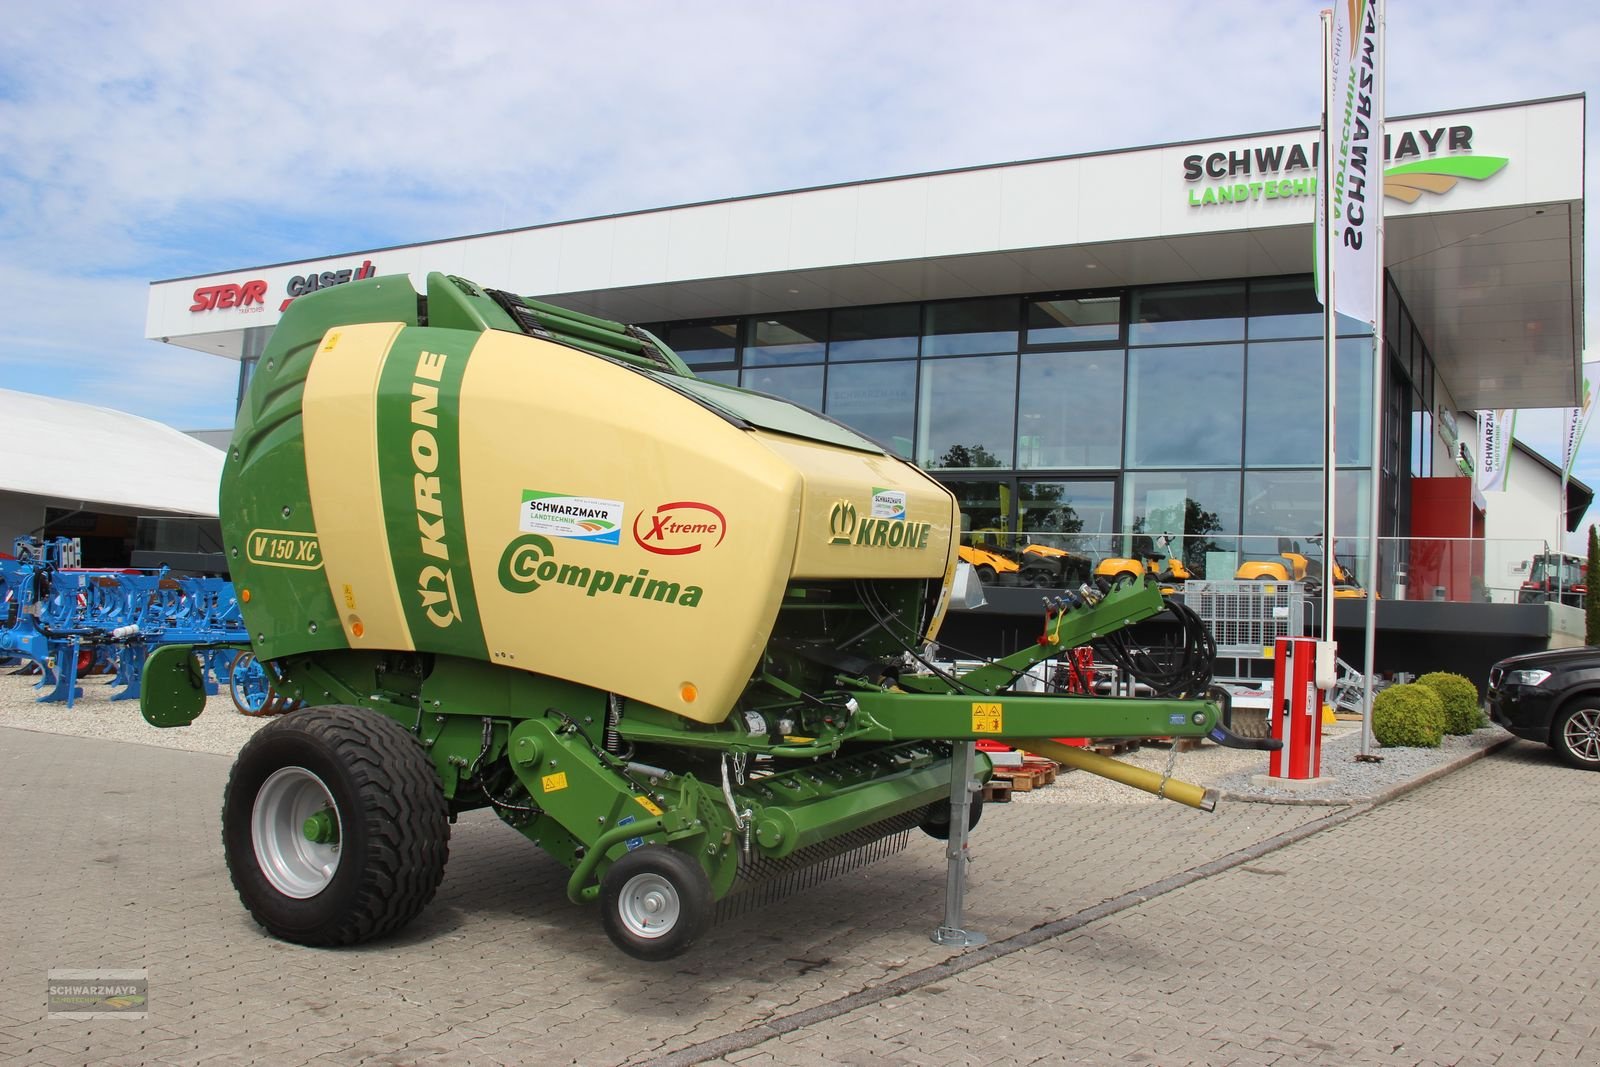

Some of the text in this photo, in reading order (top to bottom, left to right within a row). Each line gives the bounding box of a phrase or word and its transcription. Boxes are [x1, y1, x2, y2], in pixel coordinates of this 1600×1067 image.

[1183, 126, 1473, 181] SCHWAAYR
[189, 280, 268, 313] STEYR
[411, 351, 449, 560] KRONE
[530, 501, 608, 520] SCHWARZMAYR
[530, 512, 576, 525] LANDTECHNIK
[643, 515, 717, 541] X-treme
[855, 517, 931, 549] KRONE
[255, 536, 318, 561] V 150 XC
